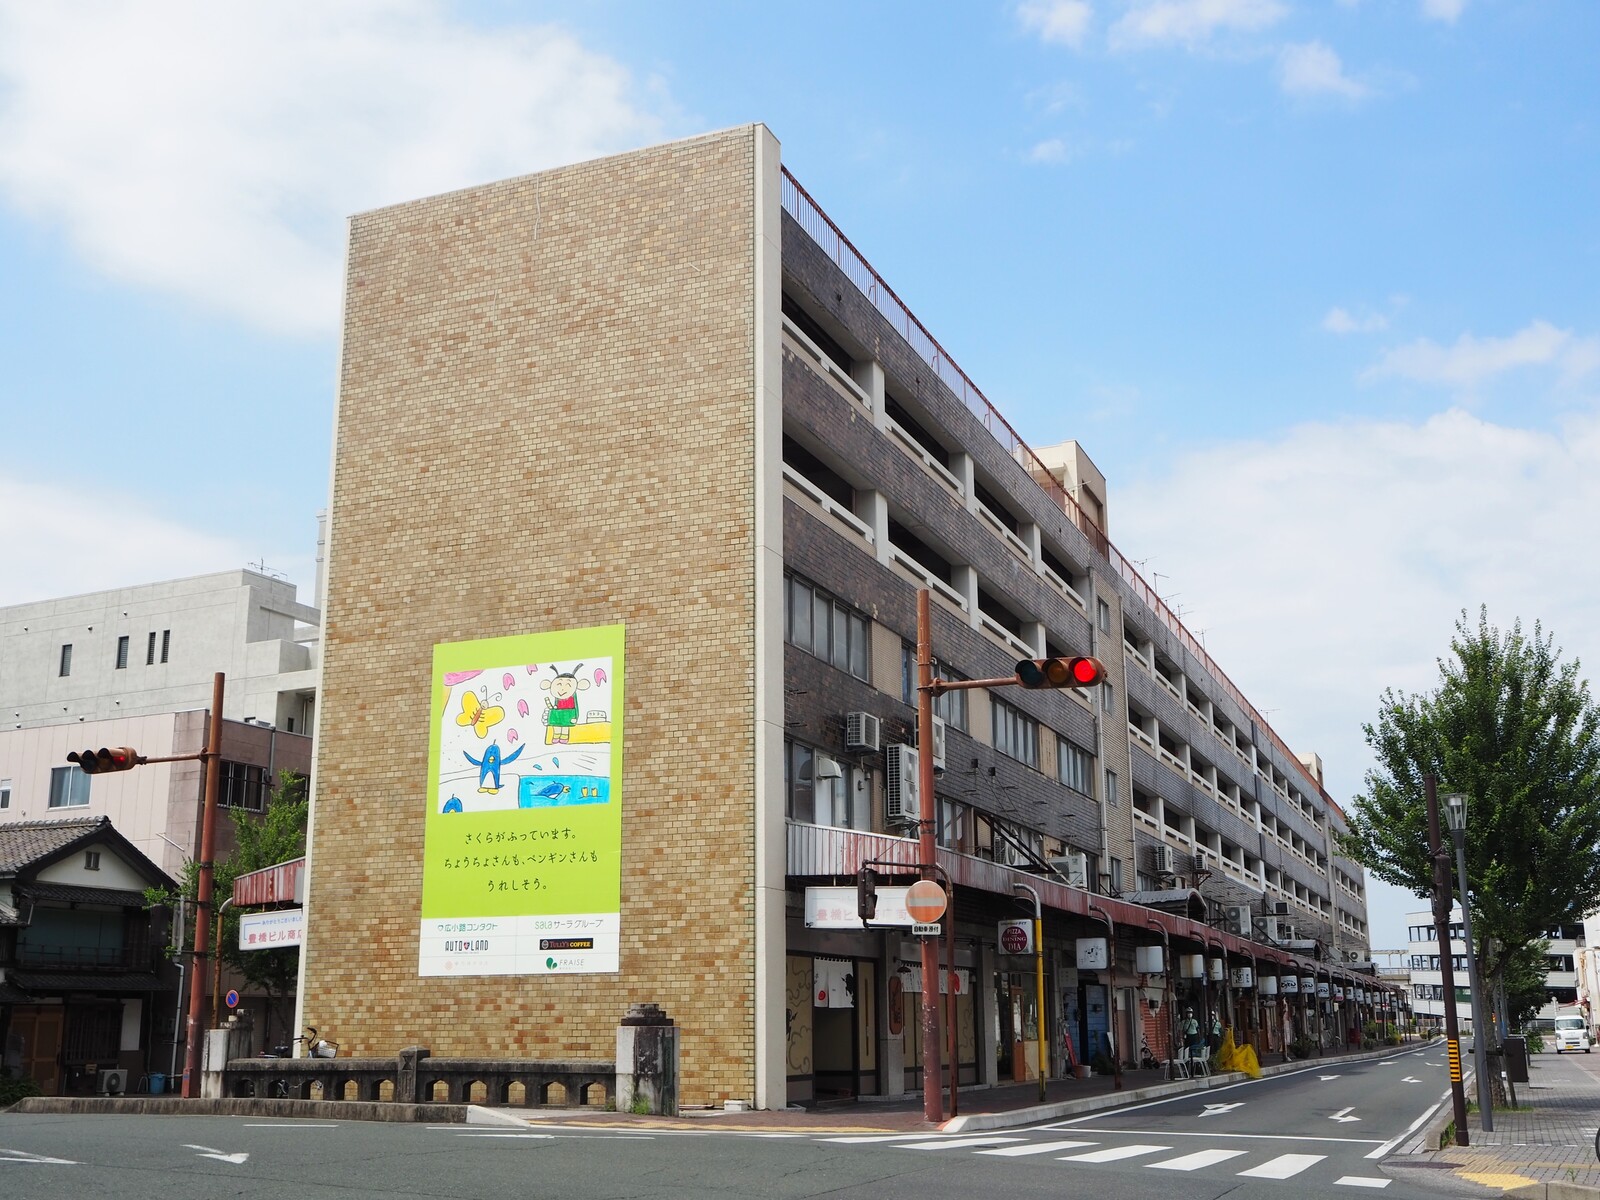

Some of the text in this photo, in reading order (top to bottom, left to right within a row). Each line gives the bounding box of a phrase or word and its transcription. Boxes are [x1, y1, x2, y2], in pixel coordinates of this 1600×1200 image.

[464, 827, 577, 845] さくらがふっています。
[443, 850, 599, 869] ちょうちょさんも、ペンギンさんも
[487, 877, 548, 893] うれしそう。
[444, 923, 498, 932] 広小路コンタクト
[553, 919, 604, 930] サーラグループ
[445, 939, 489, 951] AUTO LAND
[569, 941, 591, 949] COFFEE
[559, 958, 585, 966] FRAISE
